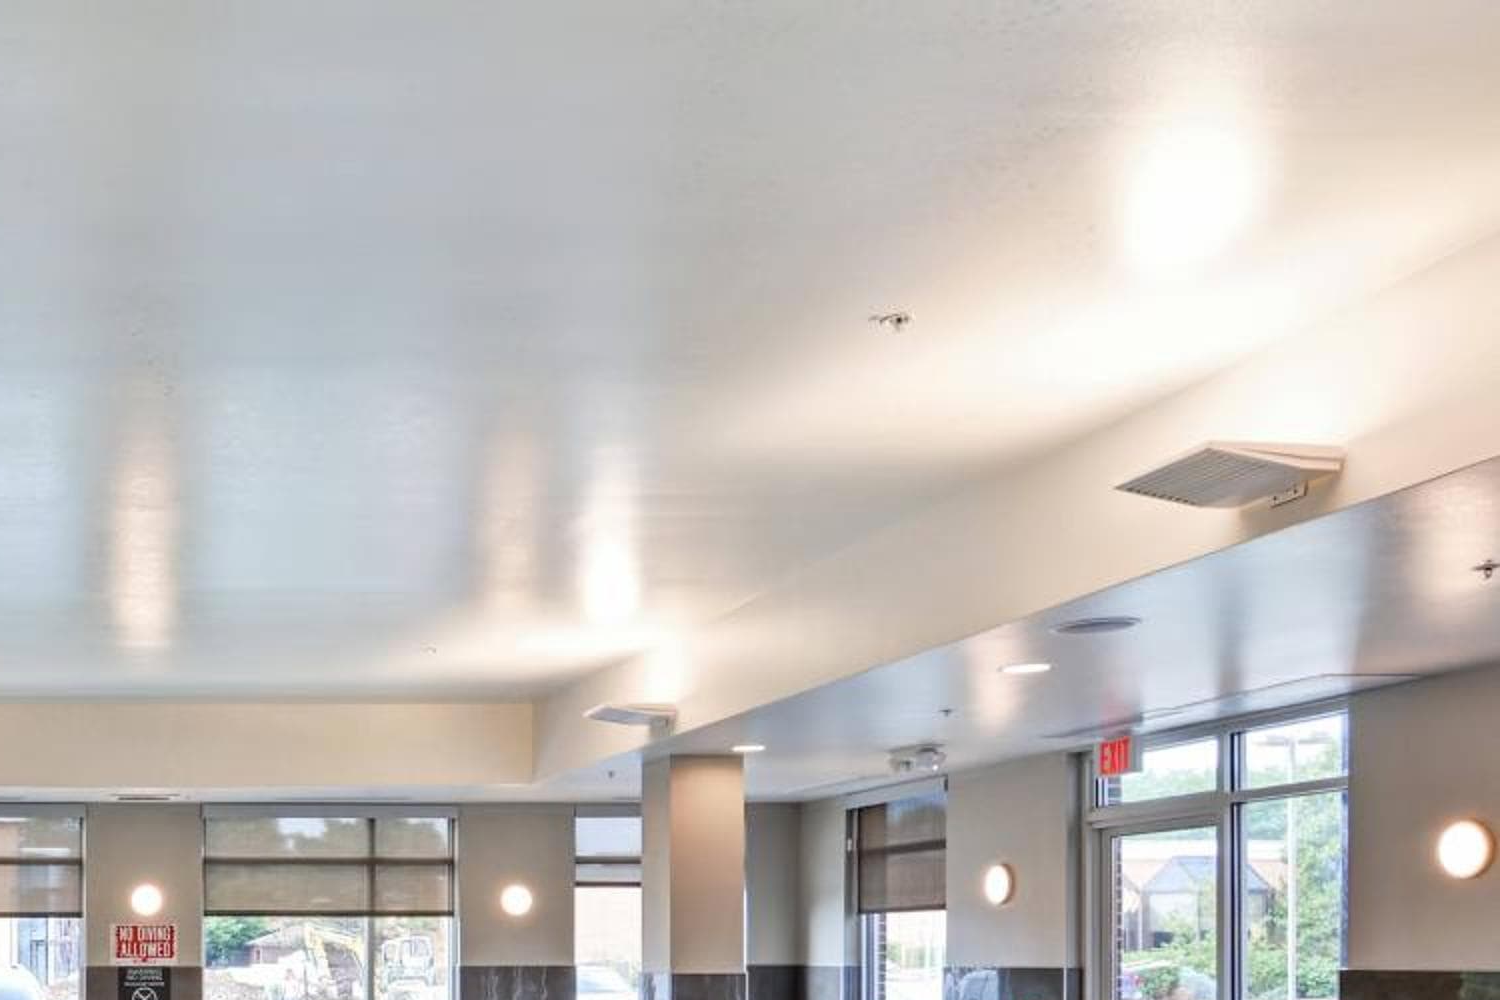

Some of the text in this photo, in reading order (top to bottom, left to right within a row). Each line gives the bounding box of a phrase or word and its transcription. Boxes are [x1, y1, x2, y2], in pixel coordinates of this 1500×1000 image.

[1100, 738, 1130, 775] EXIT
[120, 927, 170, 941] NO DIVING
[120, 942, 170, 957] ALLOWED
